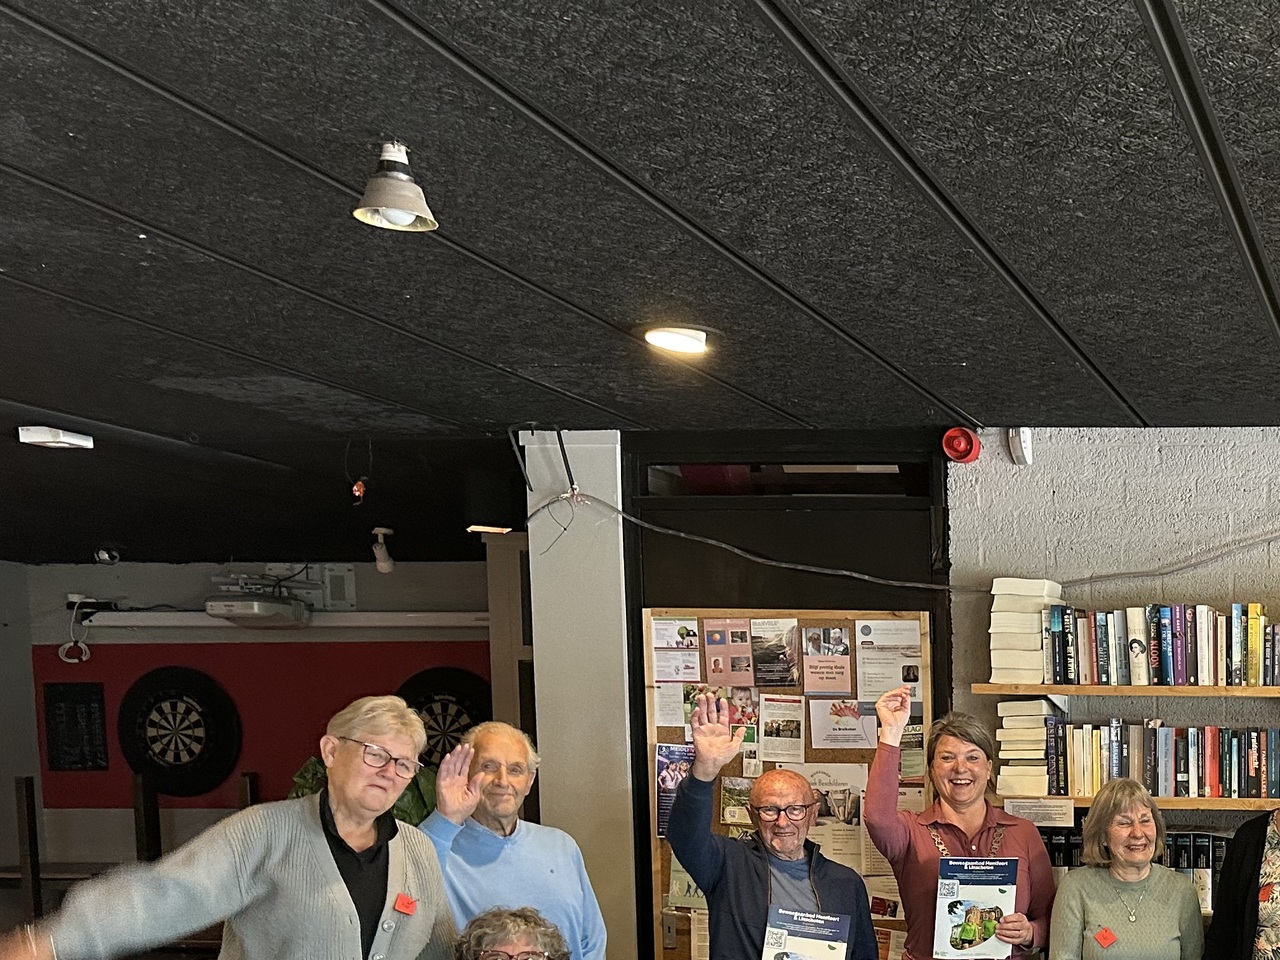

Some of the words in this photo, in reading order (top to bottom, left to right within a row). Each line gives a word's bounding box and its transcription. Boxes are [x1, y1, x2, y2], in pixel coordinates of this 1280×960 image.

[1150, 640, 1159, 668] KLOON
[1047, 721, 1056, 735] GUS
[1047, 734, 1056, 747] LEE
